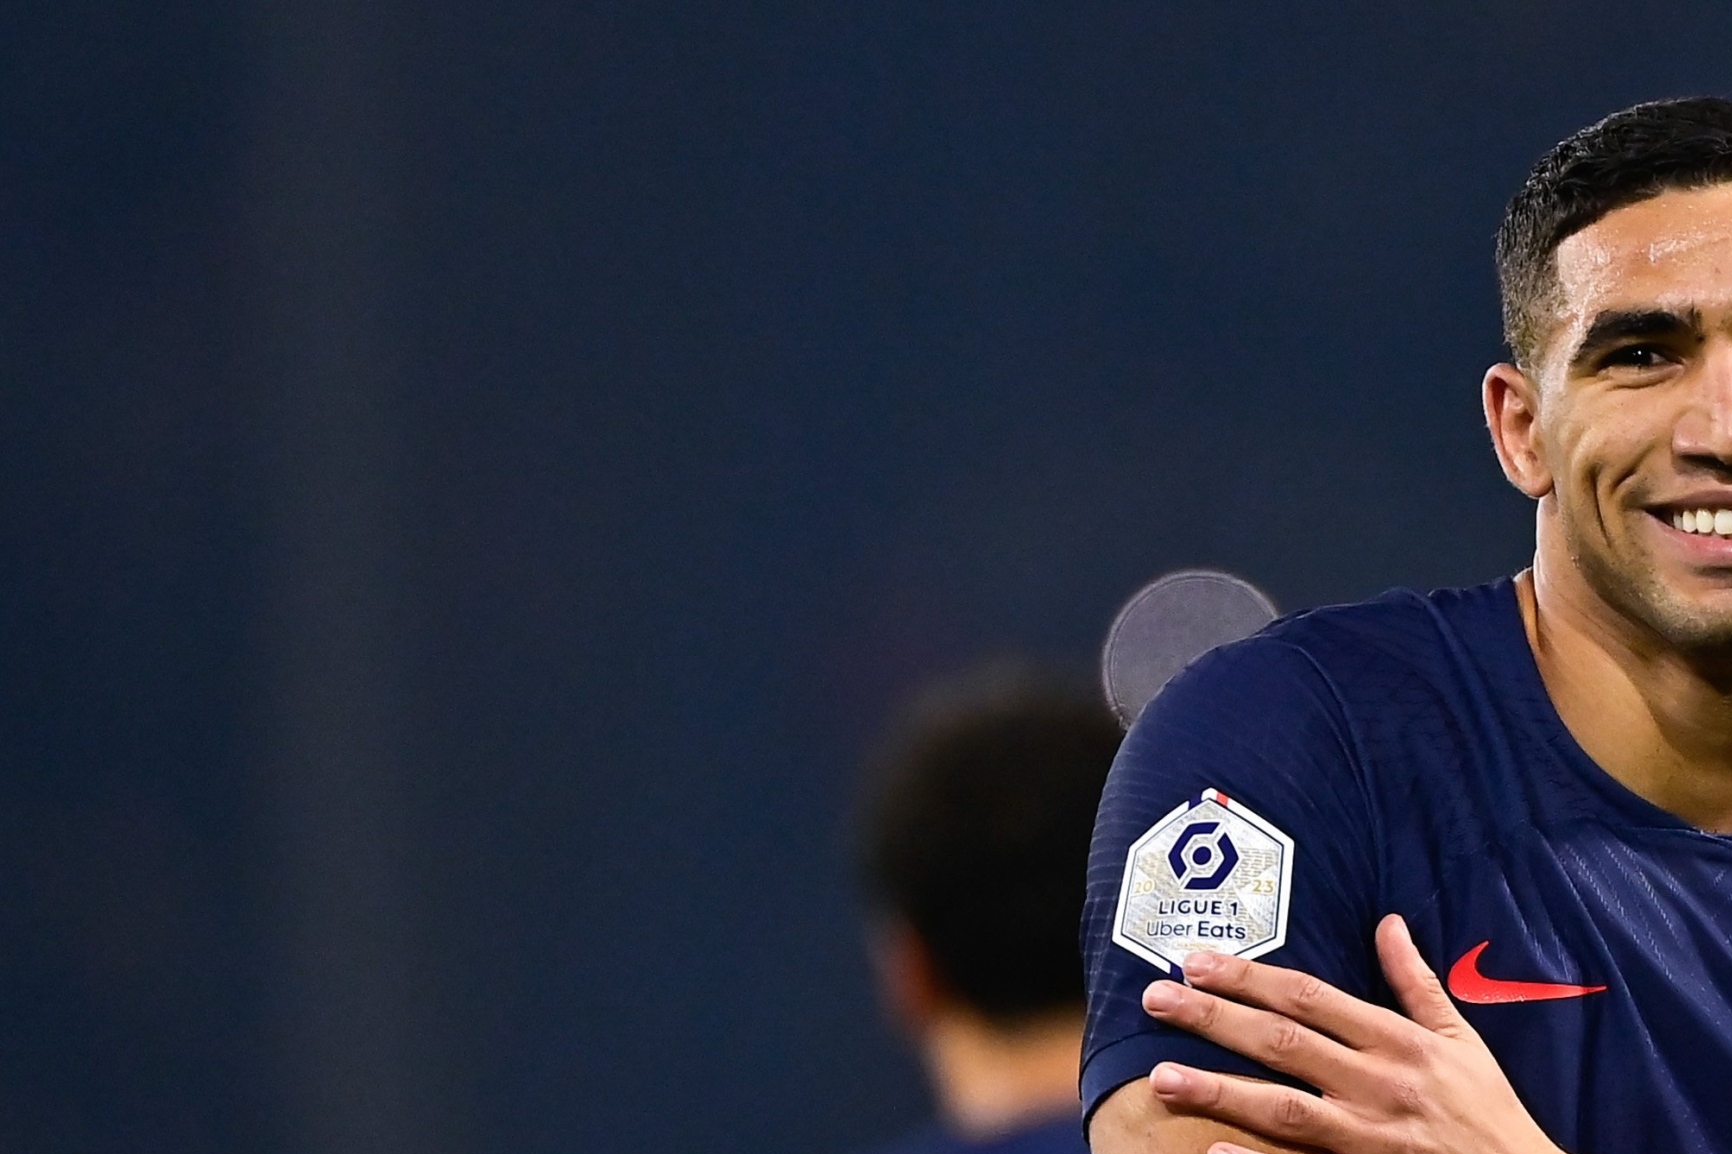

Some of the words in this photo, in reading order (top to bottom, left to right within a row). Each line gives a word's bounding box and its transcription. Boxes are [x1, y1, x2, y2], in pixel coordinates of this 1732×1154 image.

[1135, 882, 1153, 893] 20
[1252, 880, 1274, 892] 23
[1158, 900, 1222, 915] LIGUE
[1230, 902, 1237, 915] 1
[1197, 921, 1246, 939] Eats
